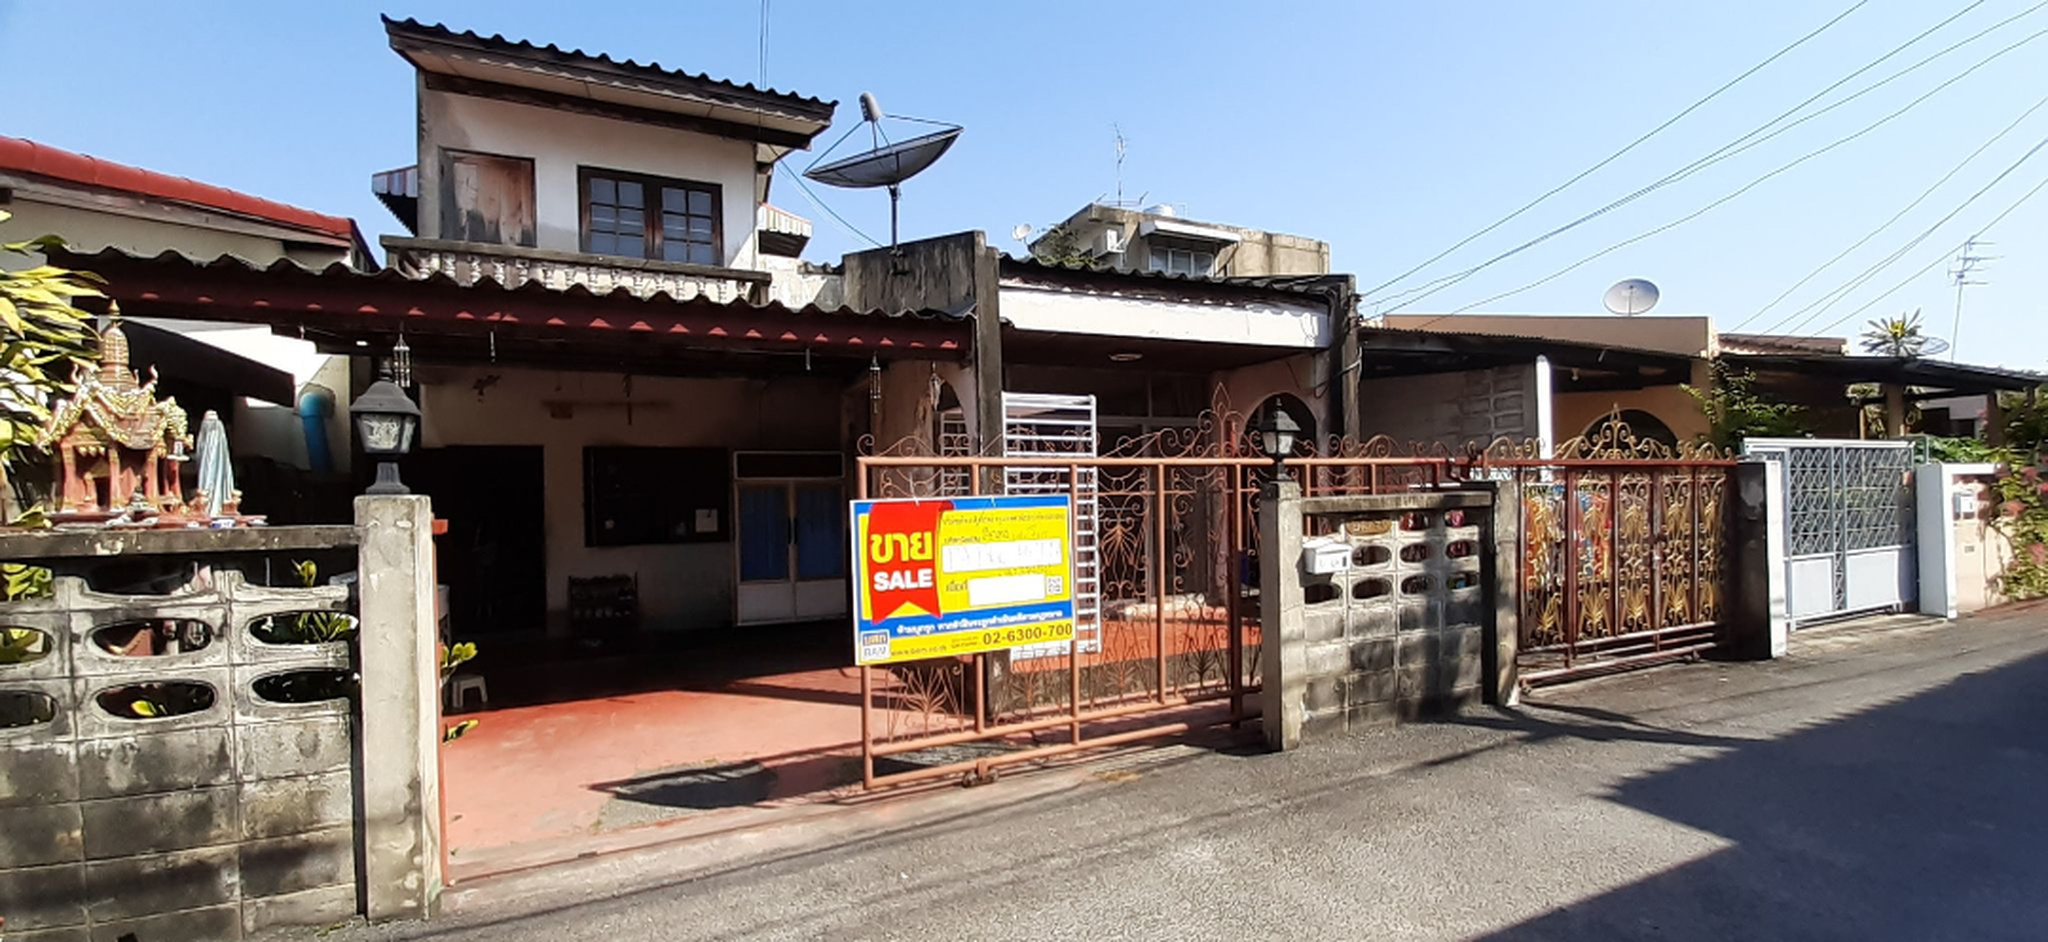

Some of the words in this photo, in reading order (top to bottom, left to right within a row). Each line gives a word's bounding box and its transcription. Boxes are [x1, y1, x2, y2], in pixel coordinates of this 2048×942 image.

[870, 531, 933, 563] ขาย
[874, 568, 933, 591] SALE
[983, 623, 1073, 645] 02-6300-700
